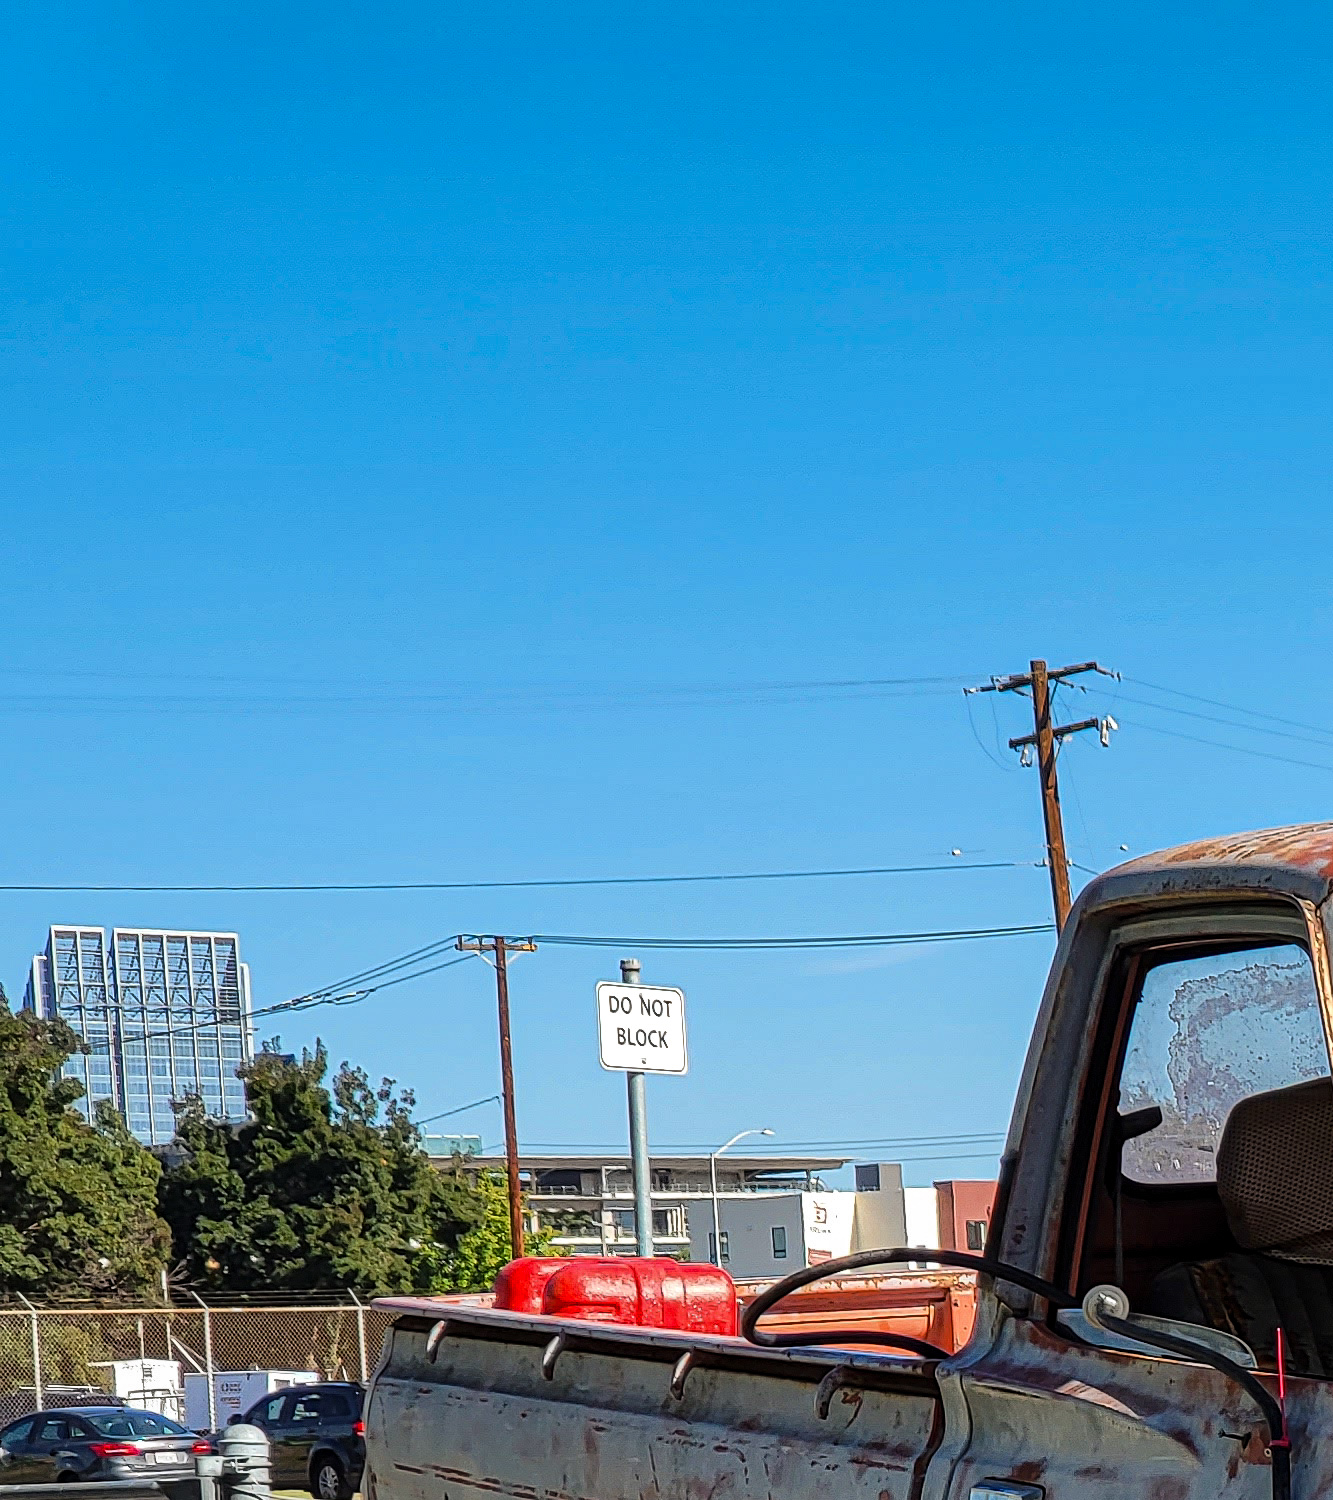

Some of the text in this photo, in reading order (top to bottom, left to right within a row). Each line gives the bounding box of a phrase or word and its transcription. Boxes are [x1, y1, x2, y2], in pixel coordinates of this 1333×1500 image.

[608, 993, 673, 1018] DO NOT
[616, 1027, 669, 1049] BLOCK
